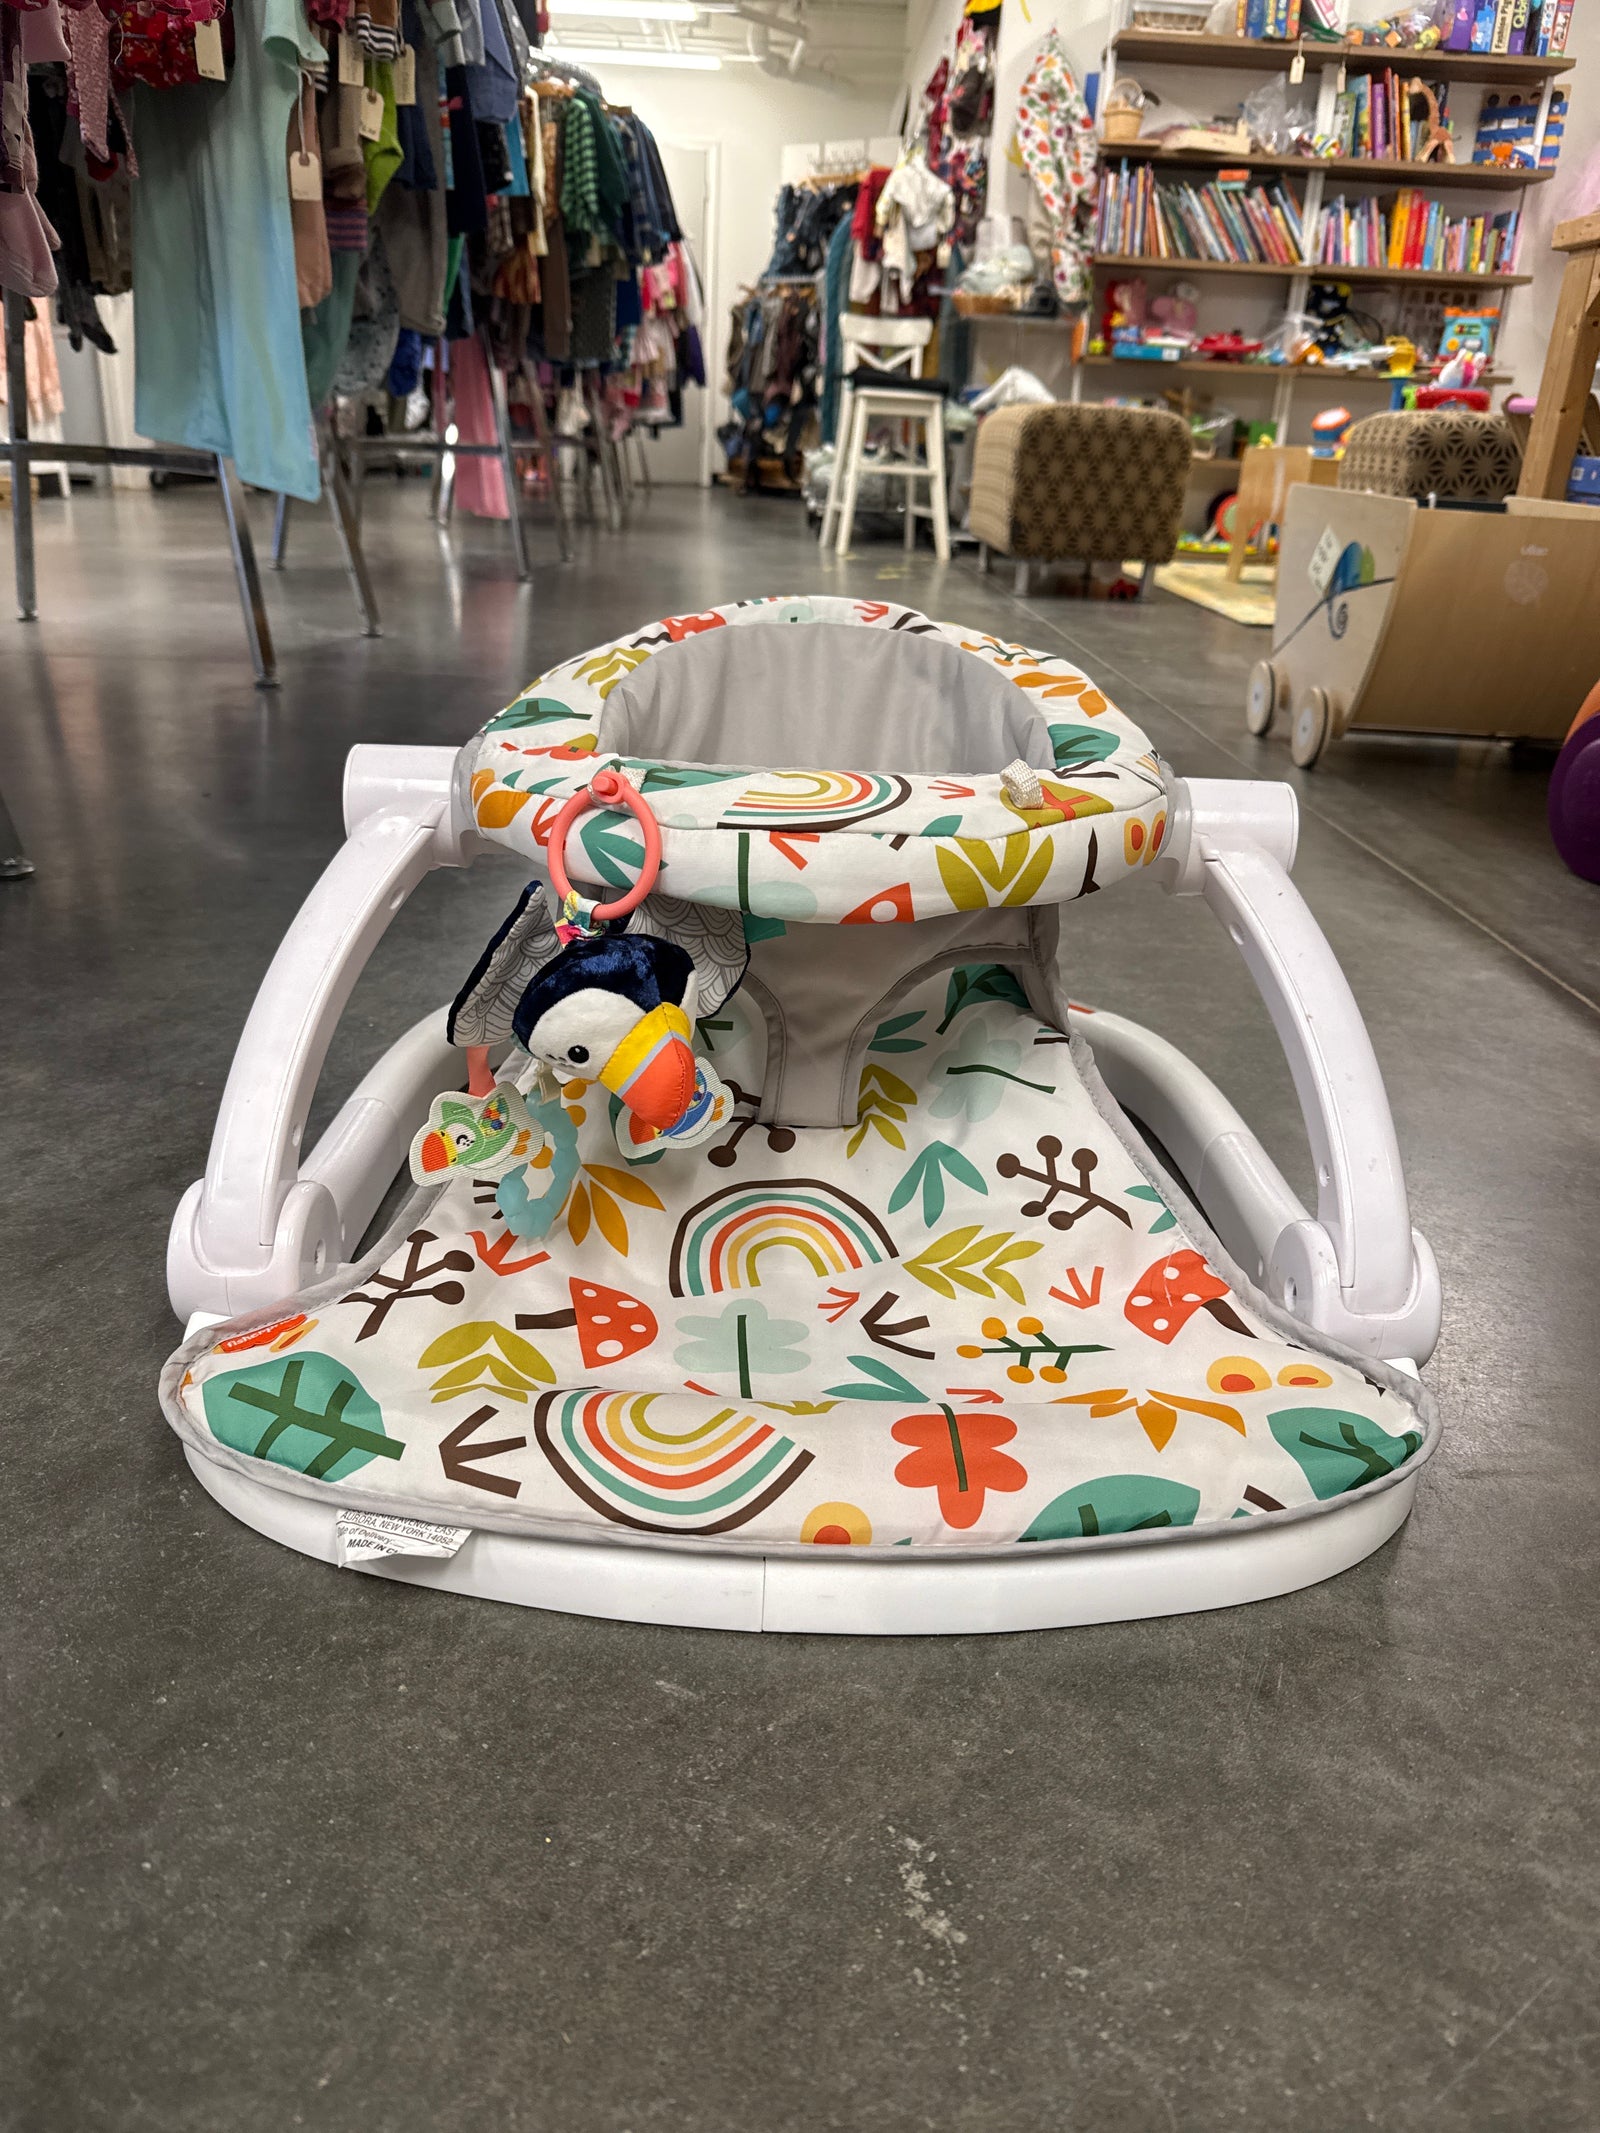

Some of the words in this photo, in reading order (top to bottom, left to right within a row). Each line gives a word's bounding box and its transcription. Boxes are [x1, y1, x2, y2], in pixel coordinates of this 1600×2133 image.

[340, 1510, 378, 1527] AURORA,
[379, 1519, 402, 1532] NEW
[401, 1525, 427, 1538] YORK
[426, 1533, 454, 1546] 14052
[434, 1524, 460, 1537] EAST
[346, 1538, 376, 1549] MADE
[373, 1543, 388, 1552] IN
